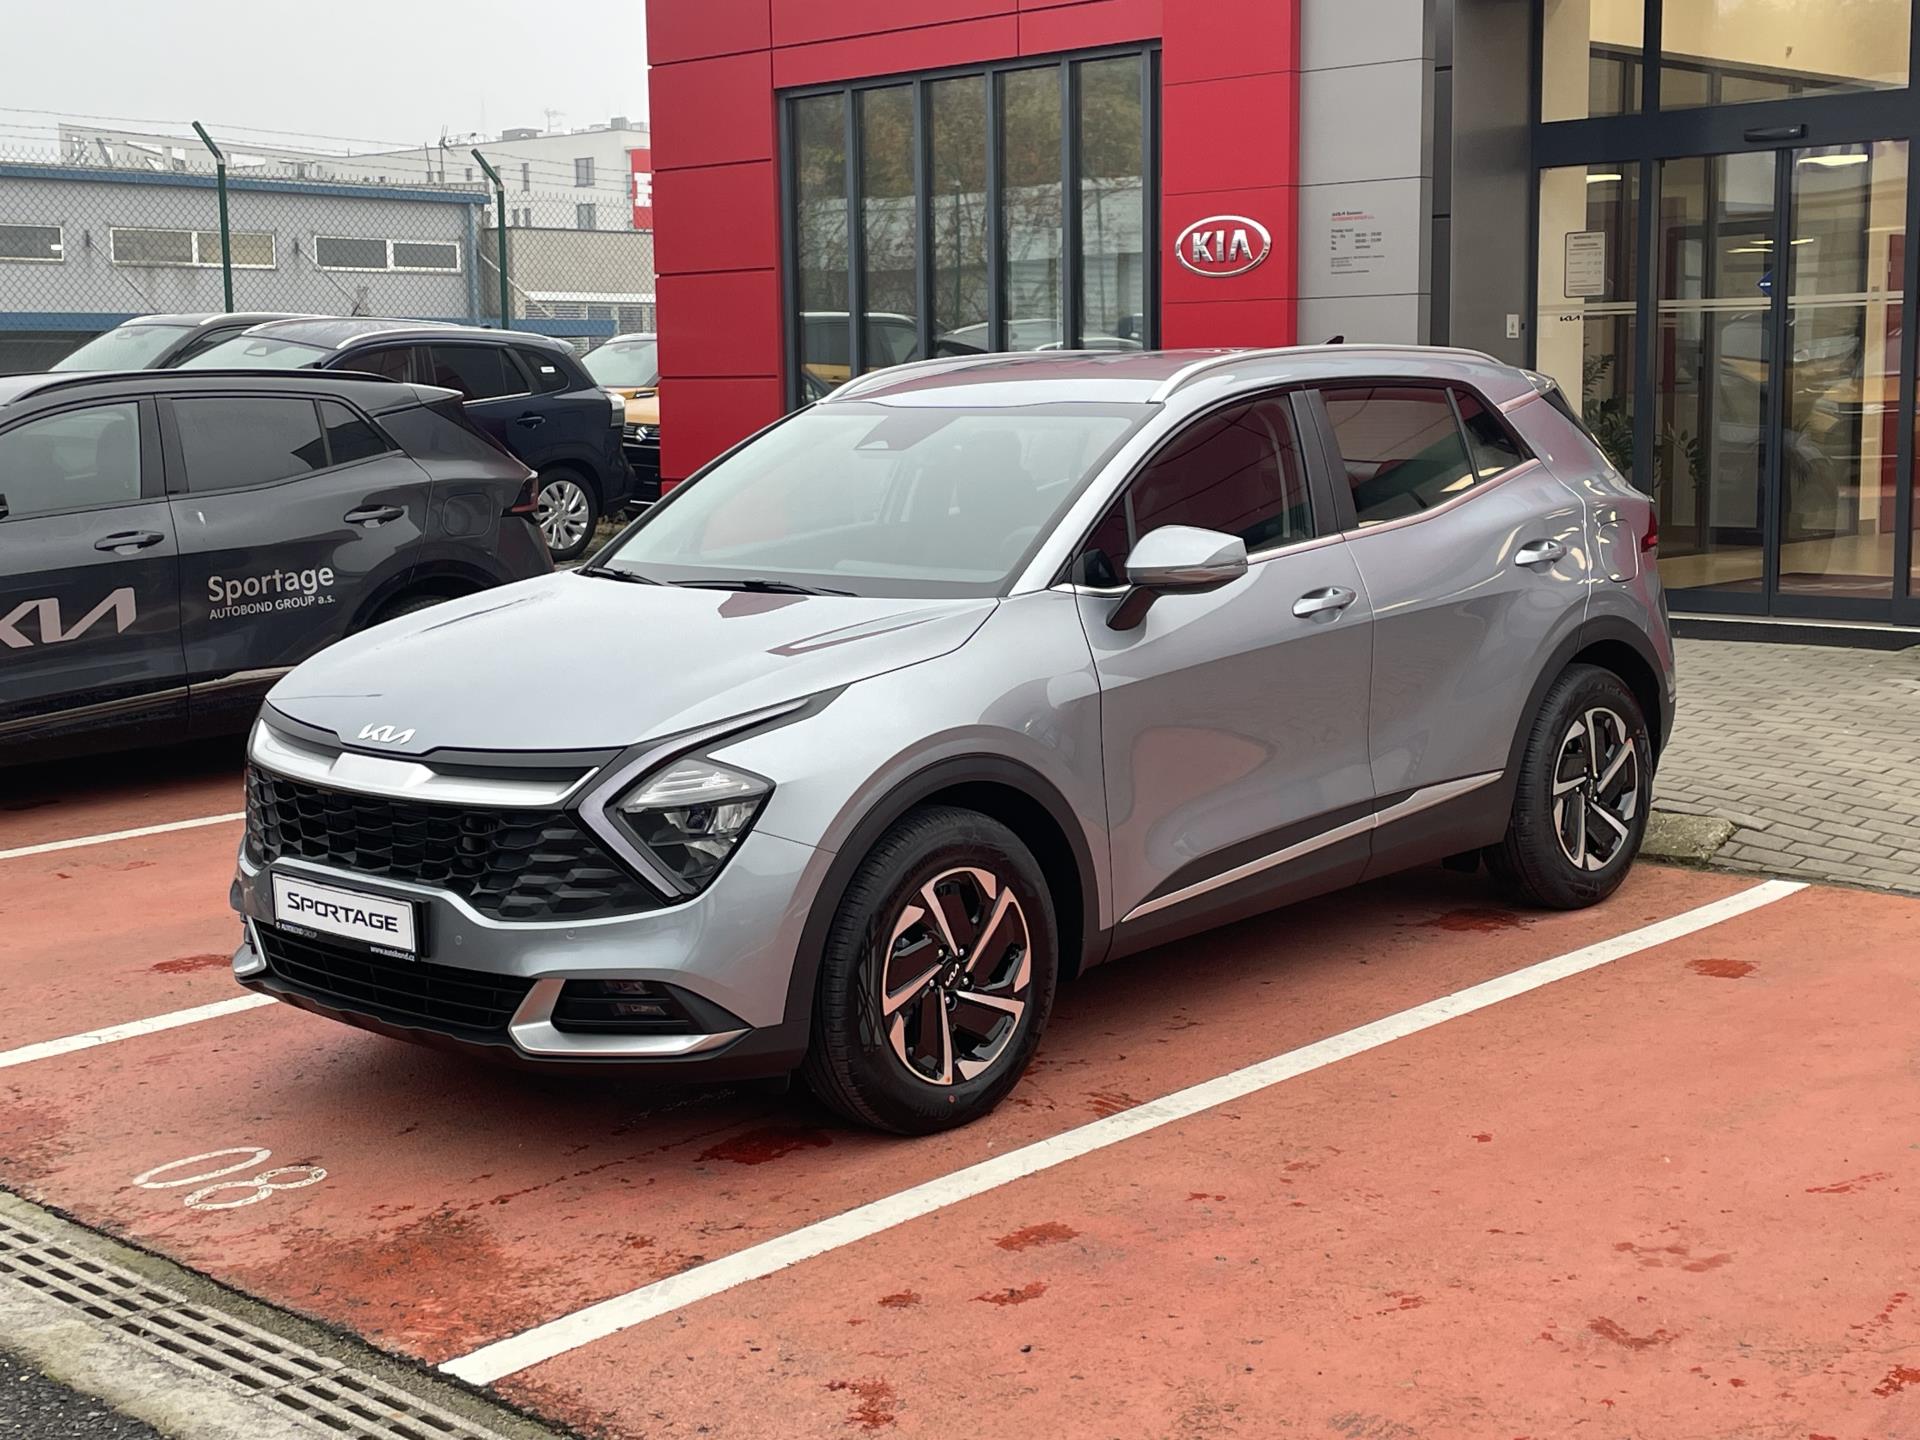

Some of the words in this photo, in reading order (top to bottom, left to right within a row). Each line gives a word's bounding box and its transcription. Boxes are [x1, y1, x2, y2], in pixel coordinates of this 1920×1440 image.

[1192, 229, 1253, 262] KIA
[207, 567, 334, 605] Sportage
[209, 601, 273, 620] AUTOBOND
[275, 595, 315, 610] GROUP
[318, 594, 335, 605] a.s.
[358, 722, 416, 745] KIA
[287, 891, 399, 933] SPORTAGE
